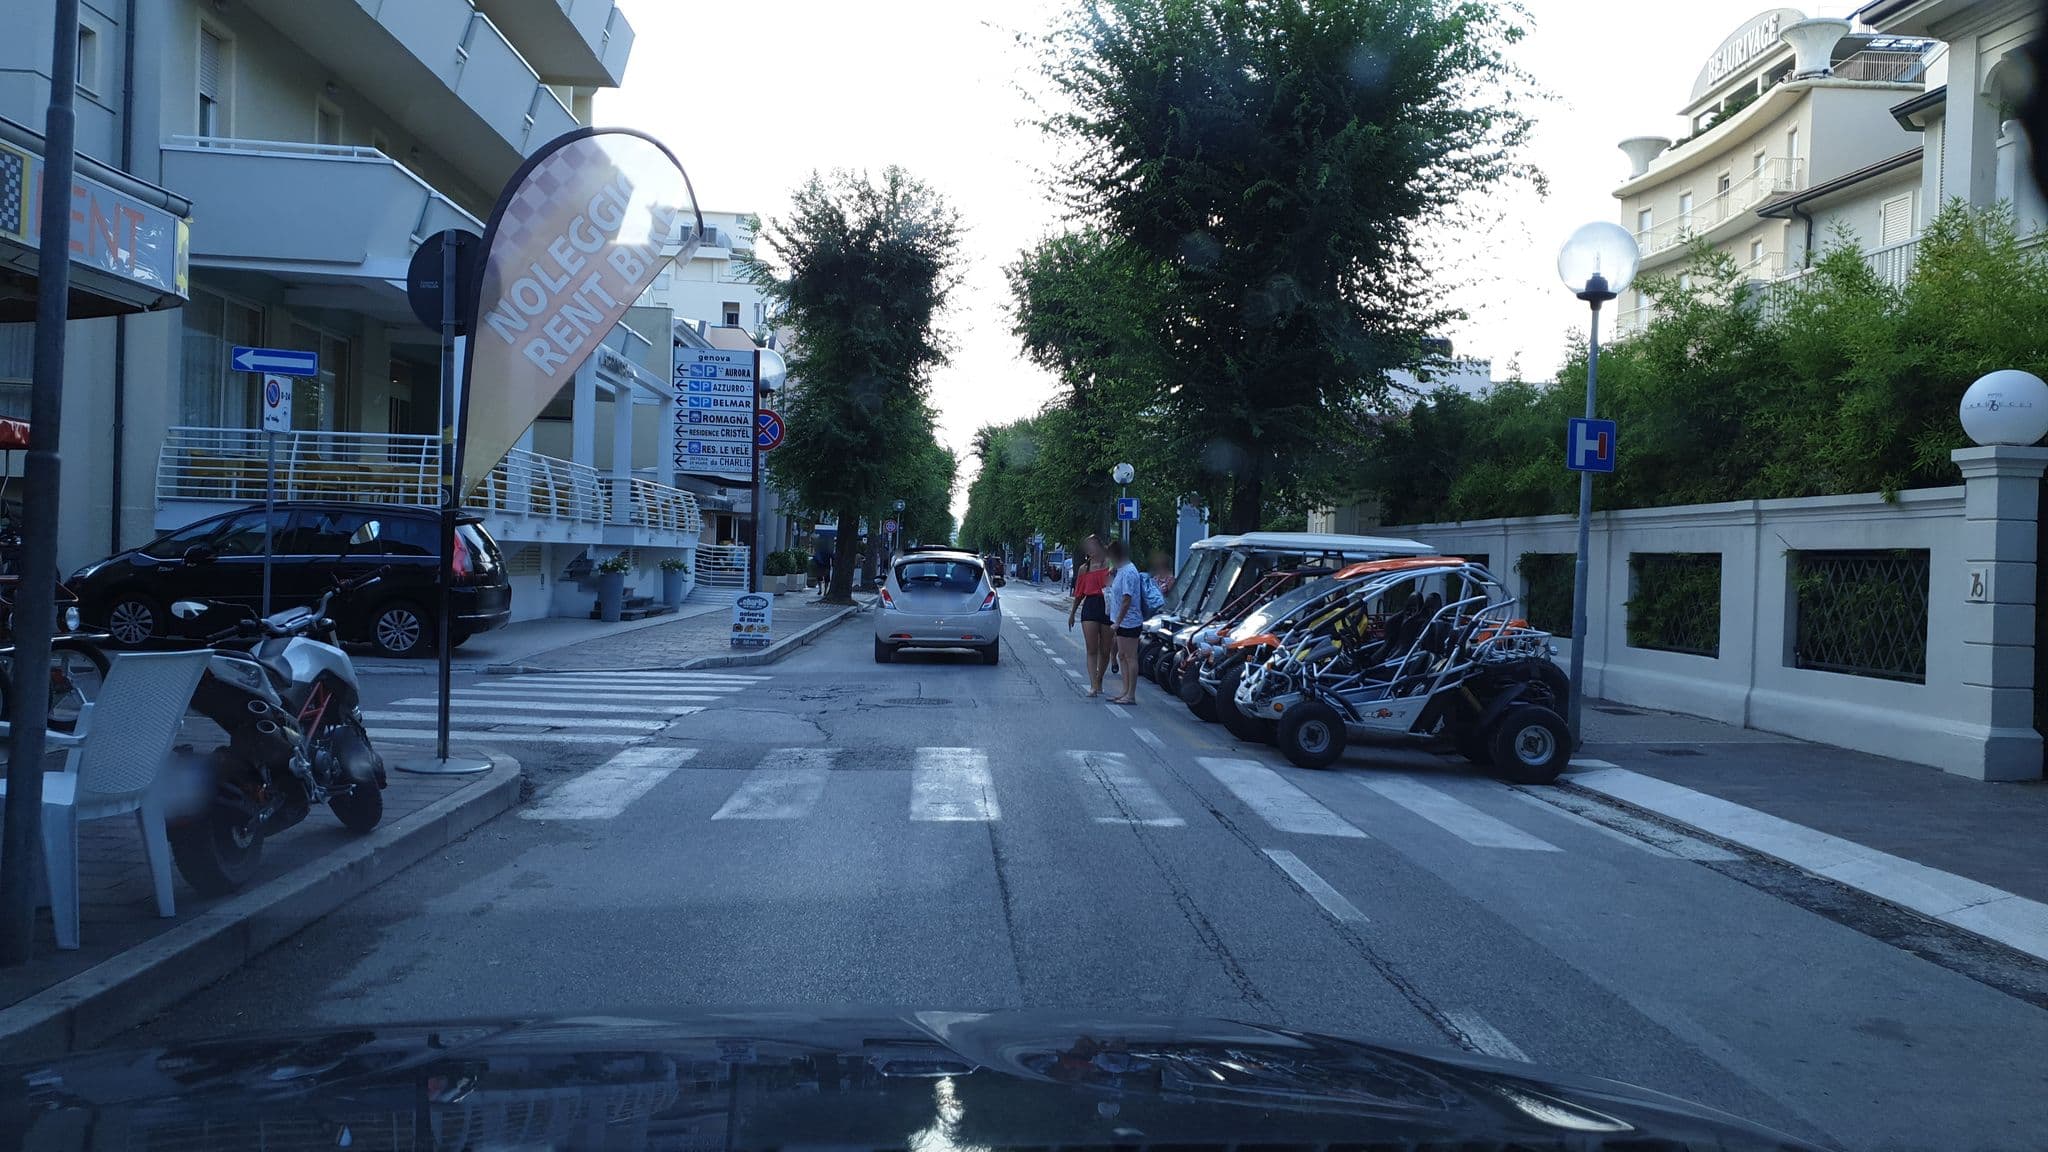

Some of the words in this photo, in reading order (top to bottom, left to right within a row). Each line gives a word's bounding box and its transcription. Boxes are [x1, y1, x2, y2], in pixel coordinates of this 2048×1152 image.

[1707, 13, 1780, 85] BEAURIVAGE
[35, 170, 144, 272] ENT
[522, 272, 618, 377] RENT
[698, 354, 731, 362] genova
[725, 367, 751, 378] AURORA
[712, 383, 745, 393] AZZURRO
[712, 398, 751, 409] BELMAR
[702, 415, 749, 425] ROMAGNA
[689, 429, 720, 438] RESIDENCE
[720, 428, 750, 439] CRISTEL
[701, 445, 718, 454] RES.
[720, 445, 729, 454] LE
[731, 446, 749, 455] VELE
[719, 458, 751, 467] CHARLIE
[1971, 573, 1984, 597] 76
